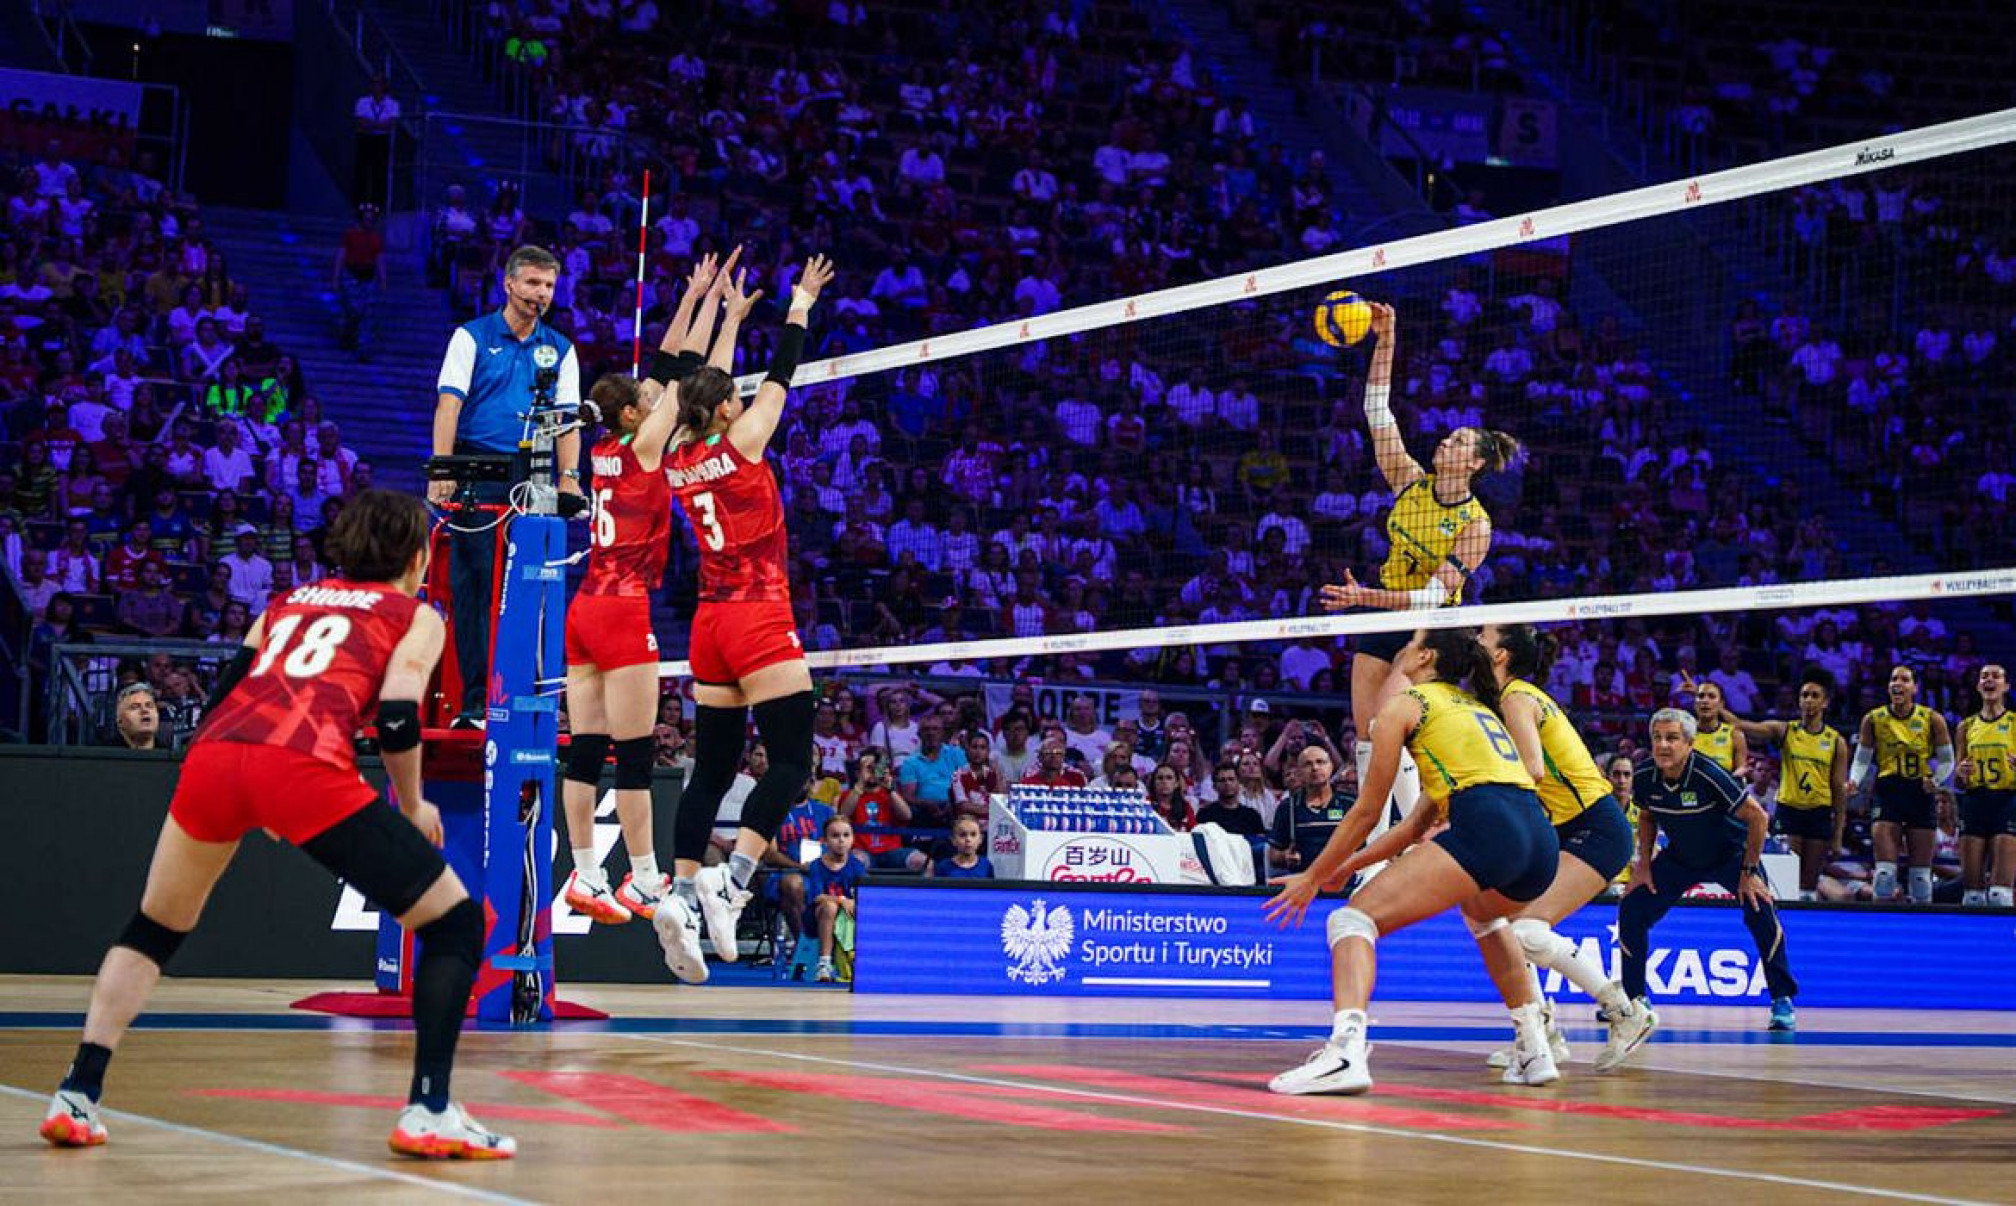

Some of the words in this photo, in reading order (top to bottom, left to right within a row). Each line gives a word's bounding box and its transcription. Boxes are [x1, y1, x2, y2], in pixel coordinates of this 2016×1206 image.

[692, 491, 725, 551] 3
[286, 585, 384, 610] SHIODE
[250, 614, 352, 678] 18
[1894, 752, 1919, 777] 18
[1976, 757, 2001, 783] 15
[1800, 771, 1812, 794] 4
[1065, 845, 1131, 866] 百岁山
[1083, 909, 1228, 934] Ministerstwo
[1081, 940, 1155, 967] Sportu
[1162, 942, 1168, 963] i
[1175, 942, 1273, 968] Turystyki
